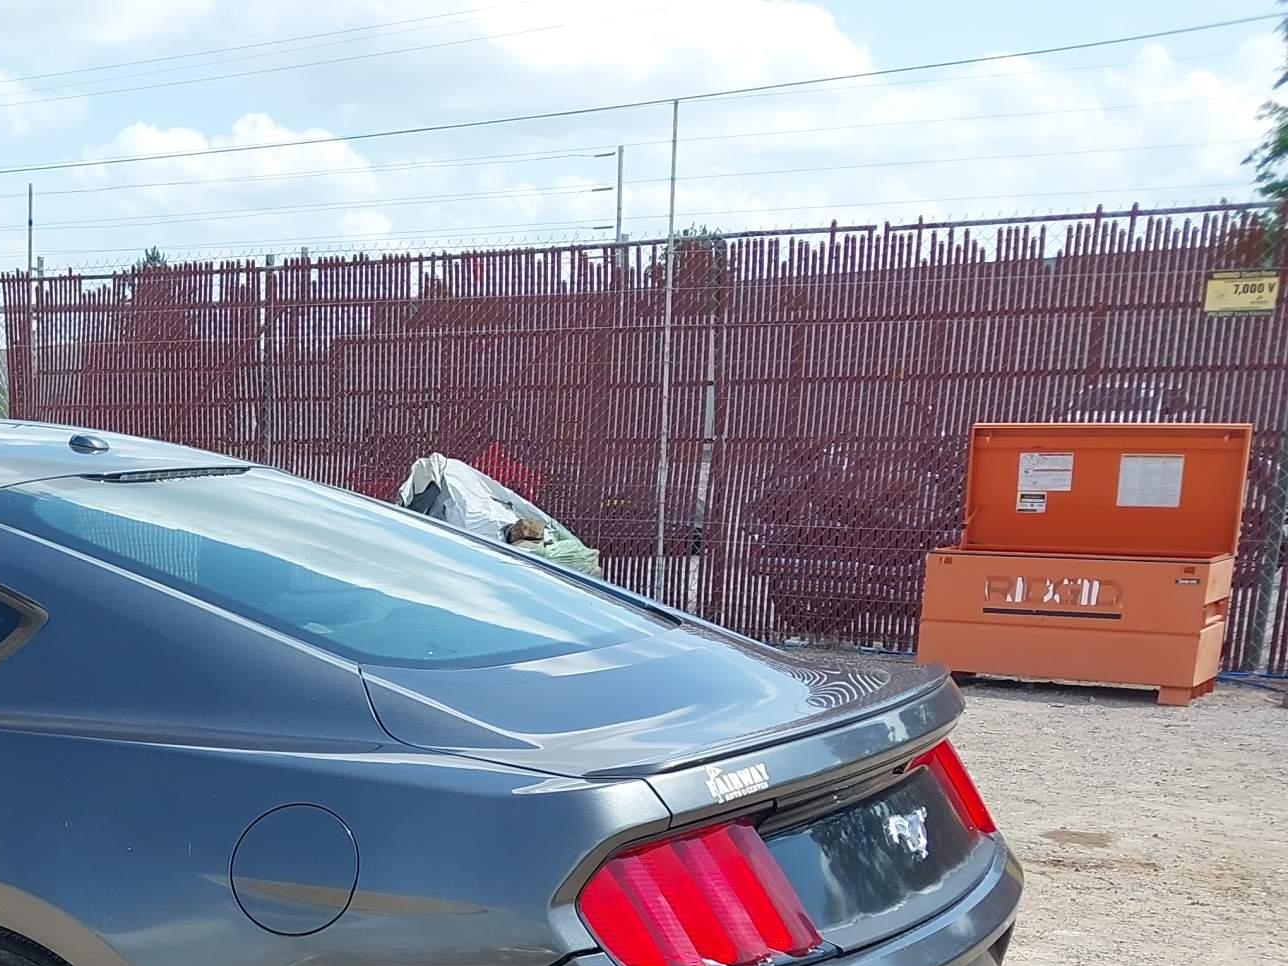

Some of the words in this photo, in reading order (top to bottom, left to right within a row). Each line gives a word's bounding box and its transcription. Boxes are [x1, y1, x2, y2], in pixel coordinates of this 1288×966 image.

[1233, 284, 1265, 296] 7,000
[1268, 283, 1276, 294] V
[705, 763, 770, 798] FAIRWAY
